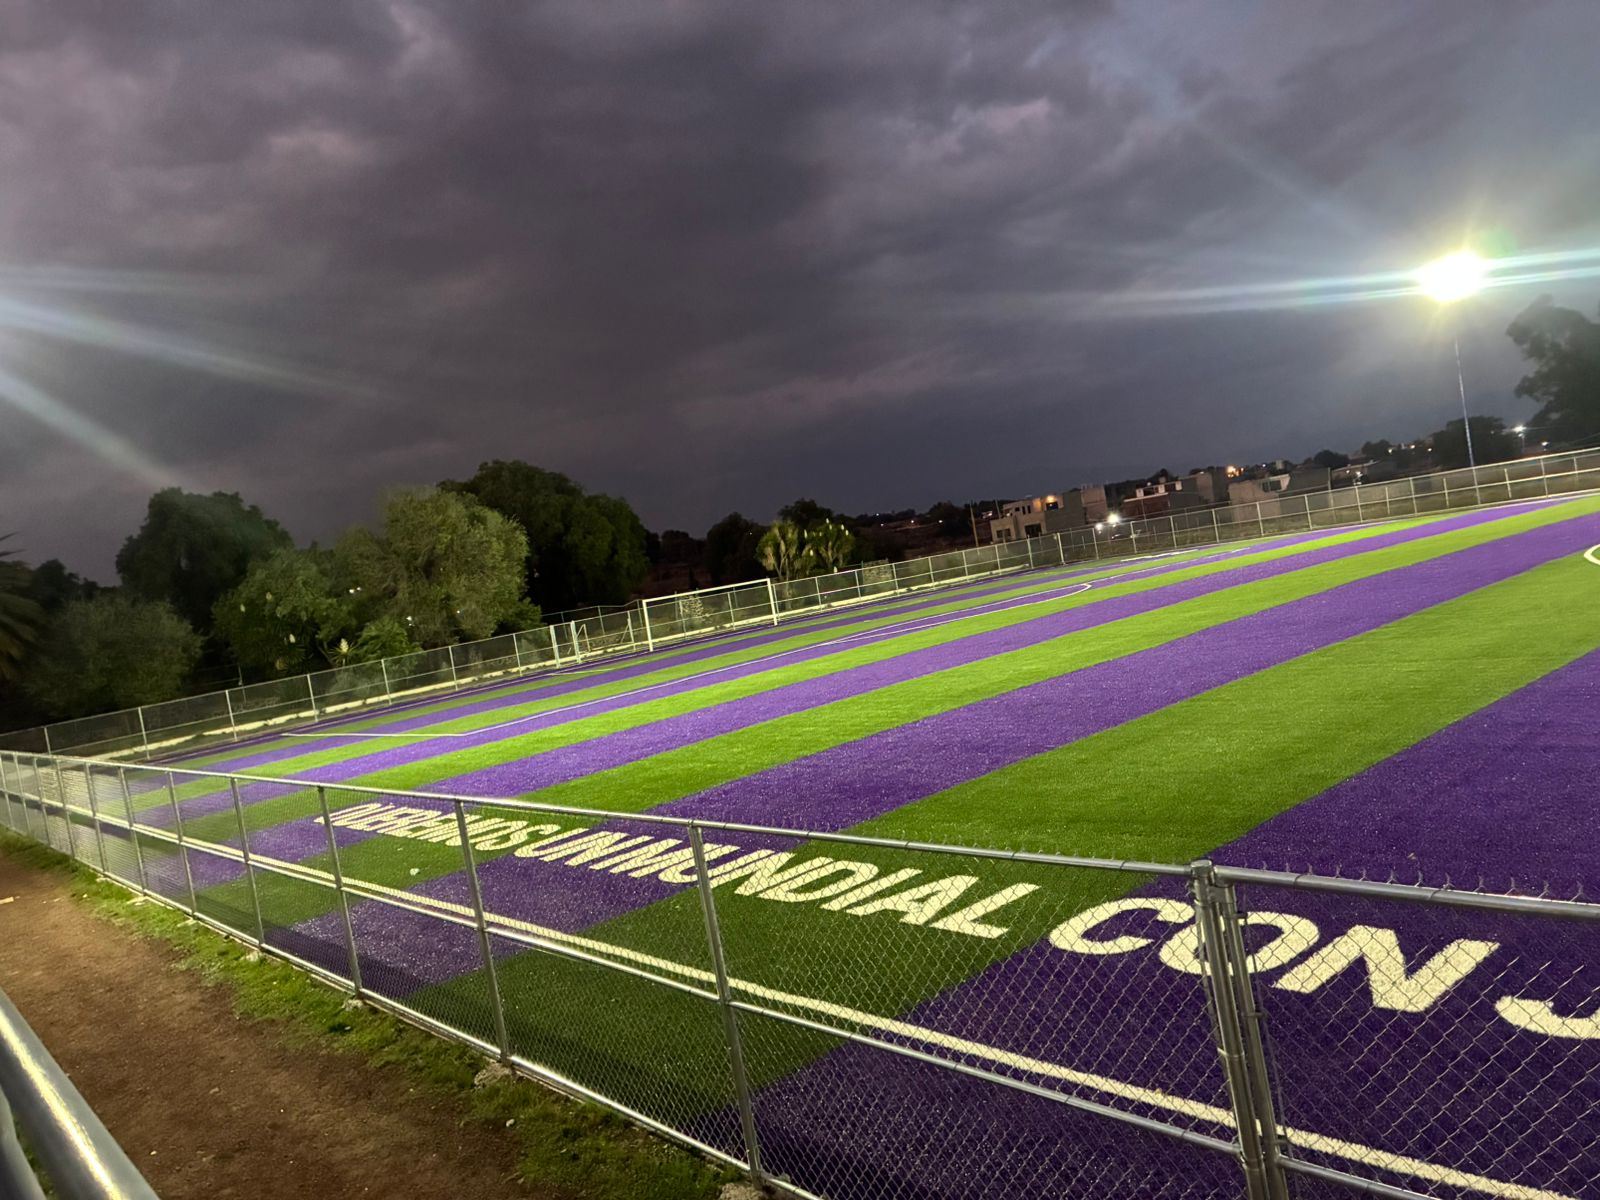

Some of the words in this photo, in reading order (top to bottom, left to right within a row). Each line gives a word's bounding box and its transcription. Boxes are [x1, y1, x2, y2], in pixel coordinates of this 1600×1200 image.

[314, 802, 560, 851] QUEREMOS
[514, 828, 655, 866] UN
[588, 838, 1042, 939] MUNDIAL
[1049, 898, 1500, 1013] CON
